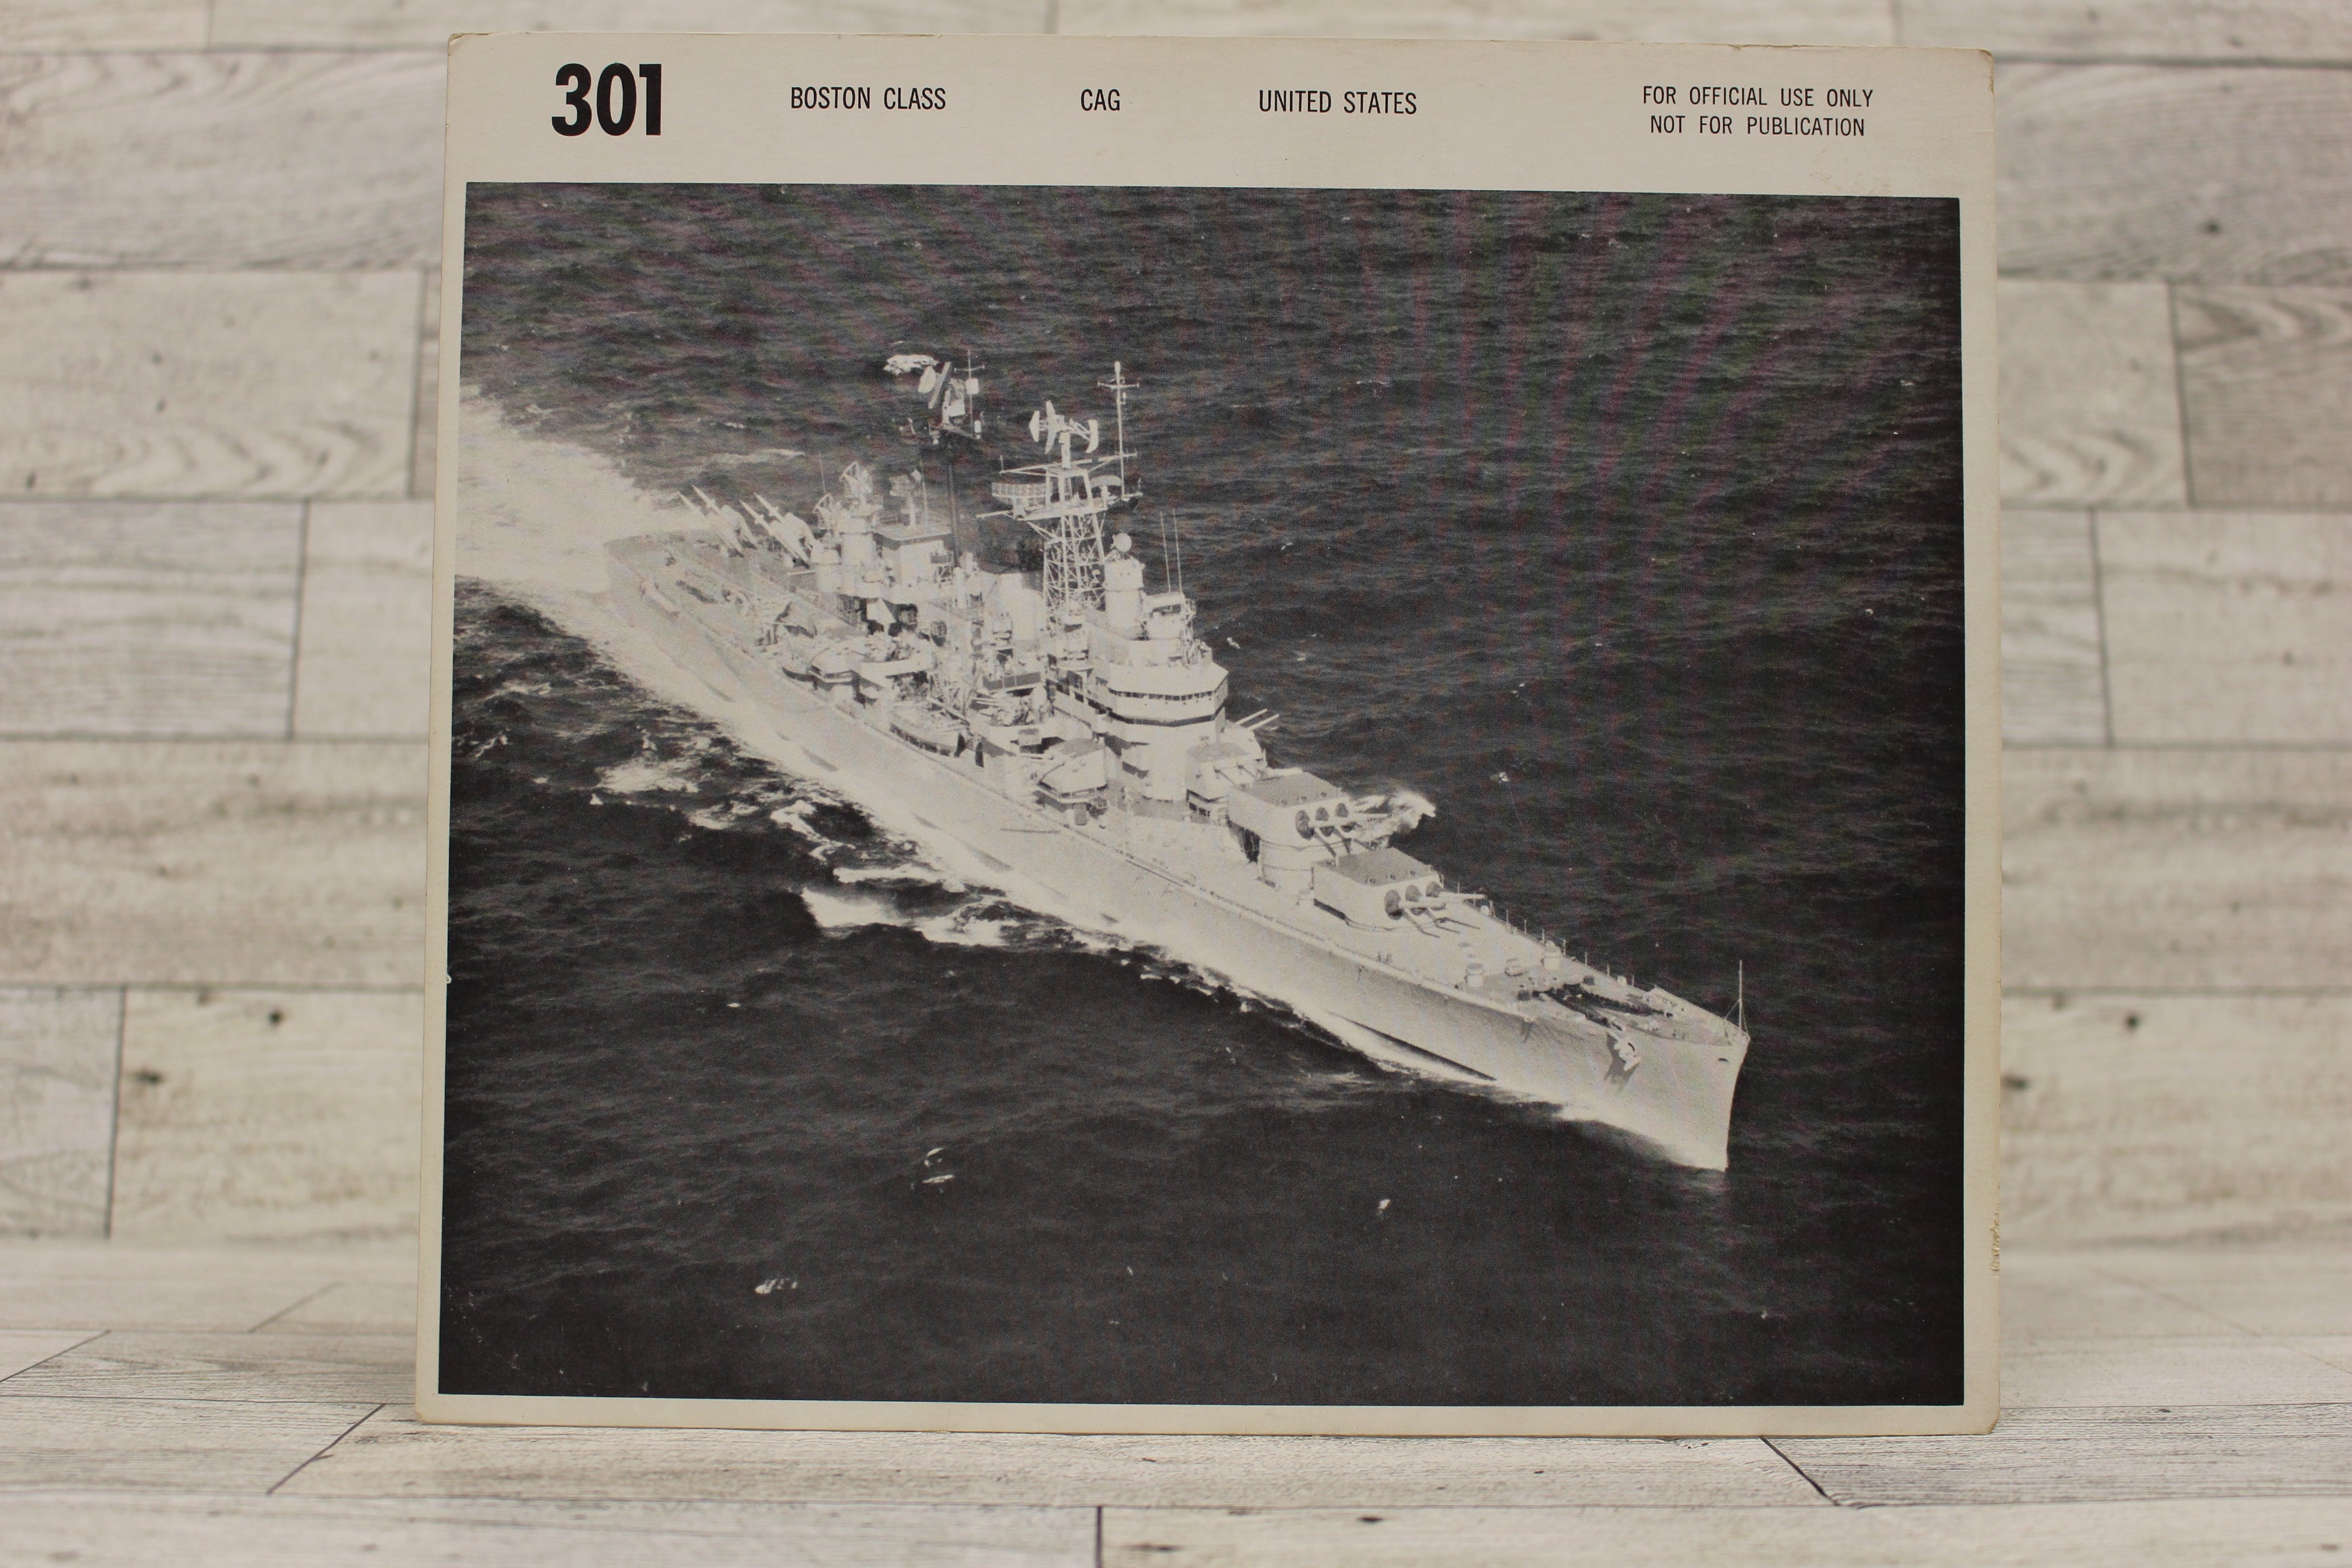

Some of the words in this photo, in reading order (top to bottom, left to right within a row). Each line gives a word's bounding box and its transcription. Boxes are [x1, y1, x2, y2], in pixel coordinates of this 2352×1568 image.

[552, 63, 662, 137] 301
[791, 86, 870, 110] BOSTON
[883, 87, 946, 110] CLASS
[1081, 88, 1120, 112] CAG
[1259, 89, 1332, 113] UNITED
[1343, 91, 1417, 115] STATES
[1643, 86, 1676, 105] FOR
[1689, 86, 1767, 105] OFFICIAL
[1780, 88, 1814, 107] USE
[1827, 88, 1874, 108] ONLY
[1650, 115, 1686, 133] NOT
[1699, 116, 1733, 134] FOR
[1747, 116, 1864, 137] PUBLICATION
